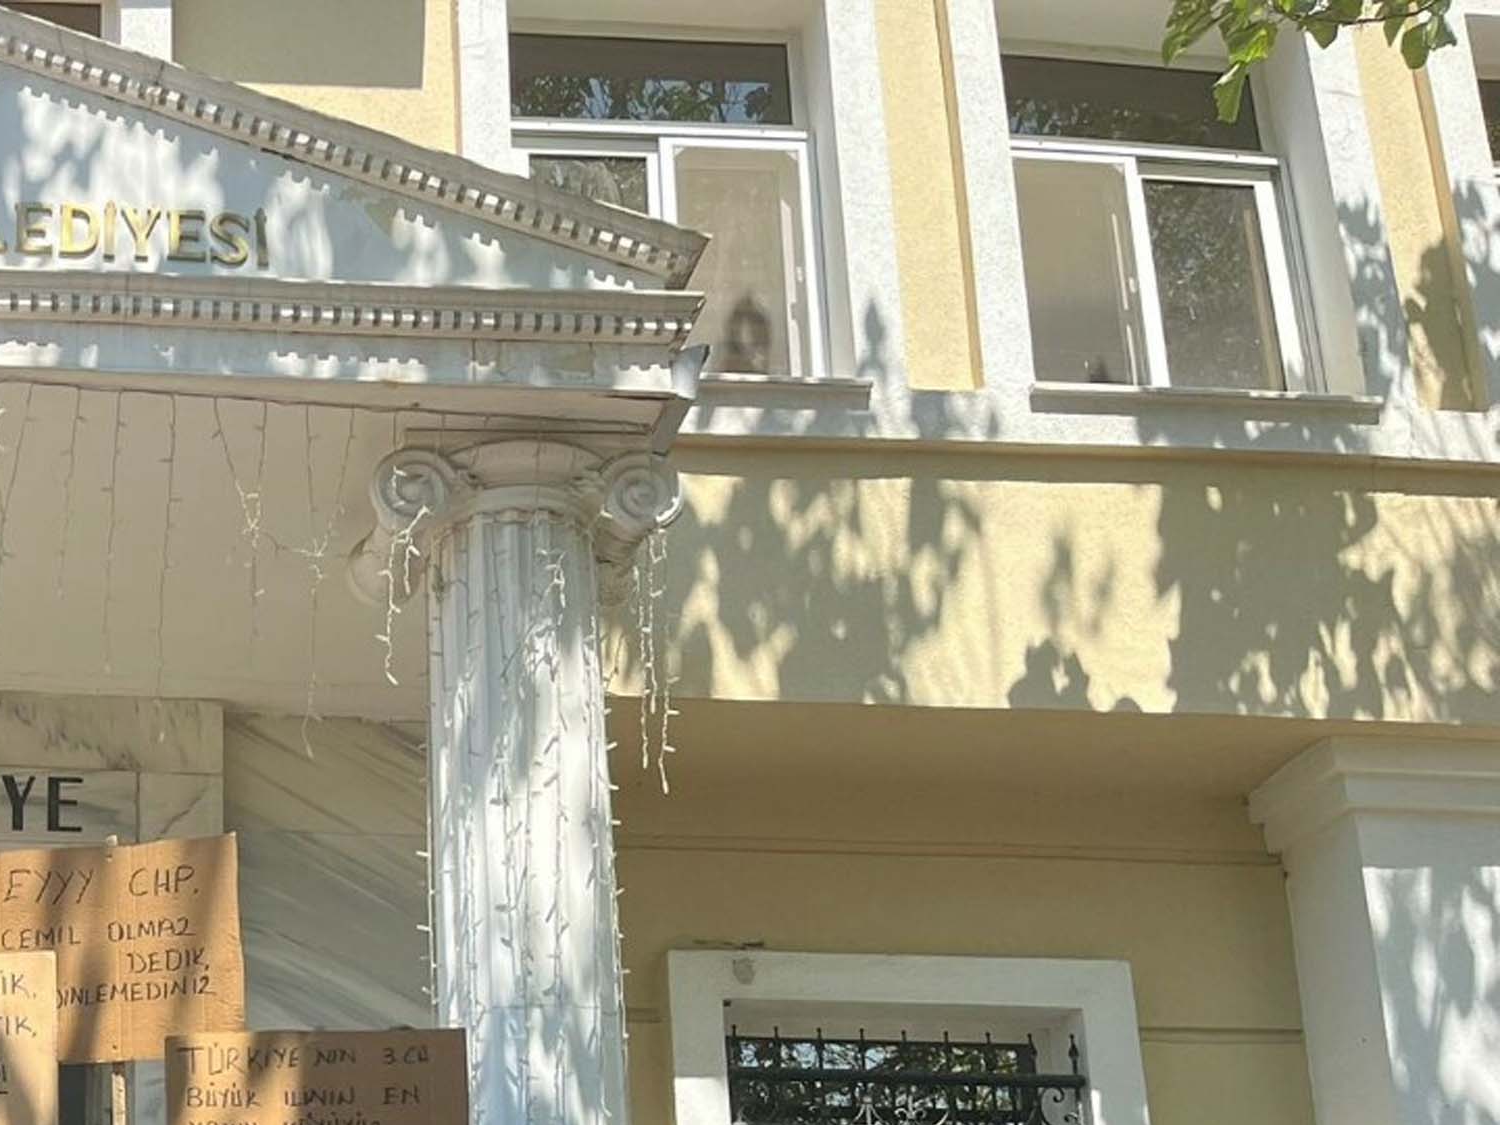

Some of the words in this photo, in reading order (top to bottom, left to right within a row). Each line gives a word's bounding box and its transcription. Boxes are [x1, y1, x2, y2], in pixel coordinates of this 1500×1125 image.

[4, 867, 94, 904] EYYY
[107, 917, 196, 943] OLMAZ
[187, 1081, 261, 1109] BÜYÜK
[383, 1085, 421, 1105] EN
